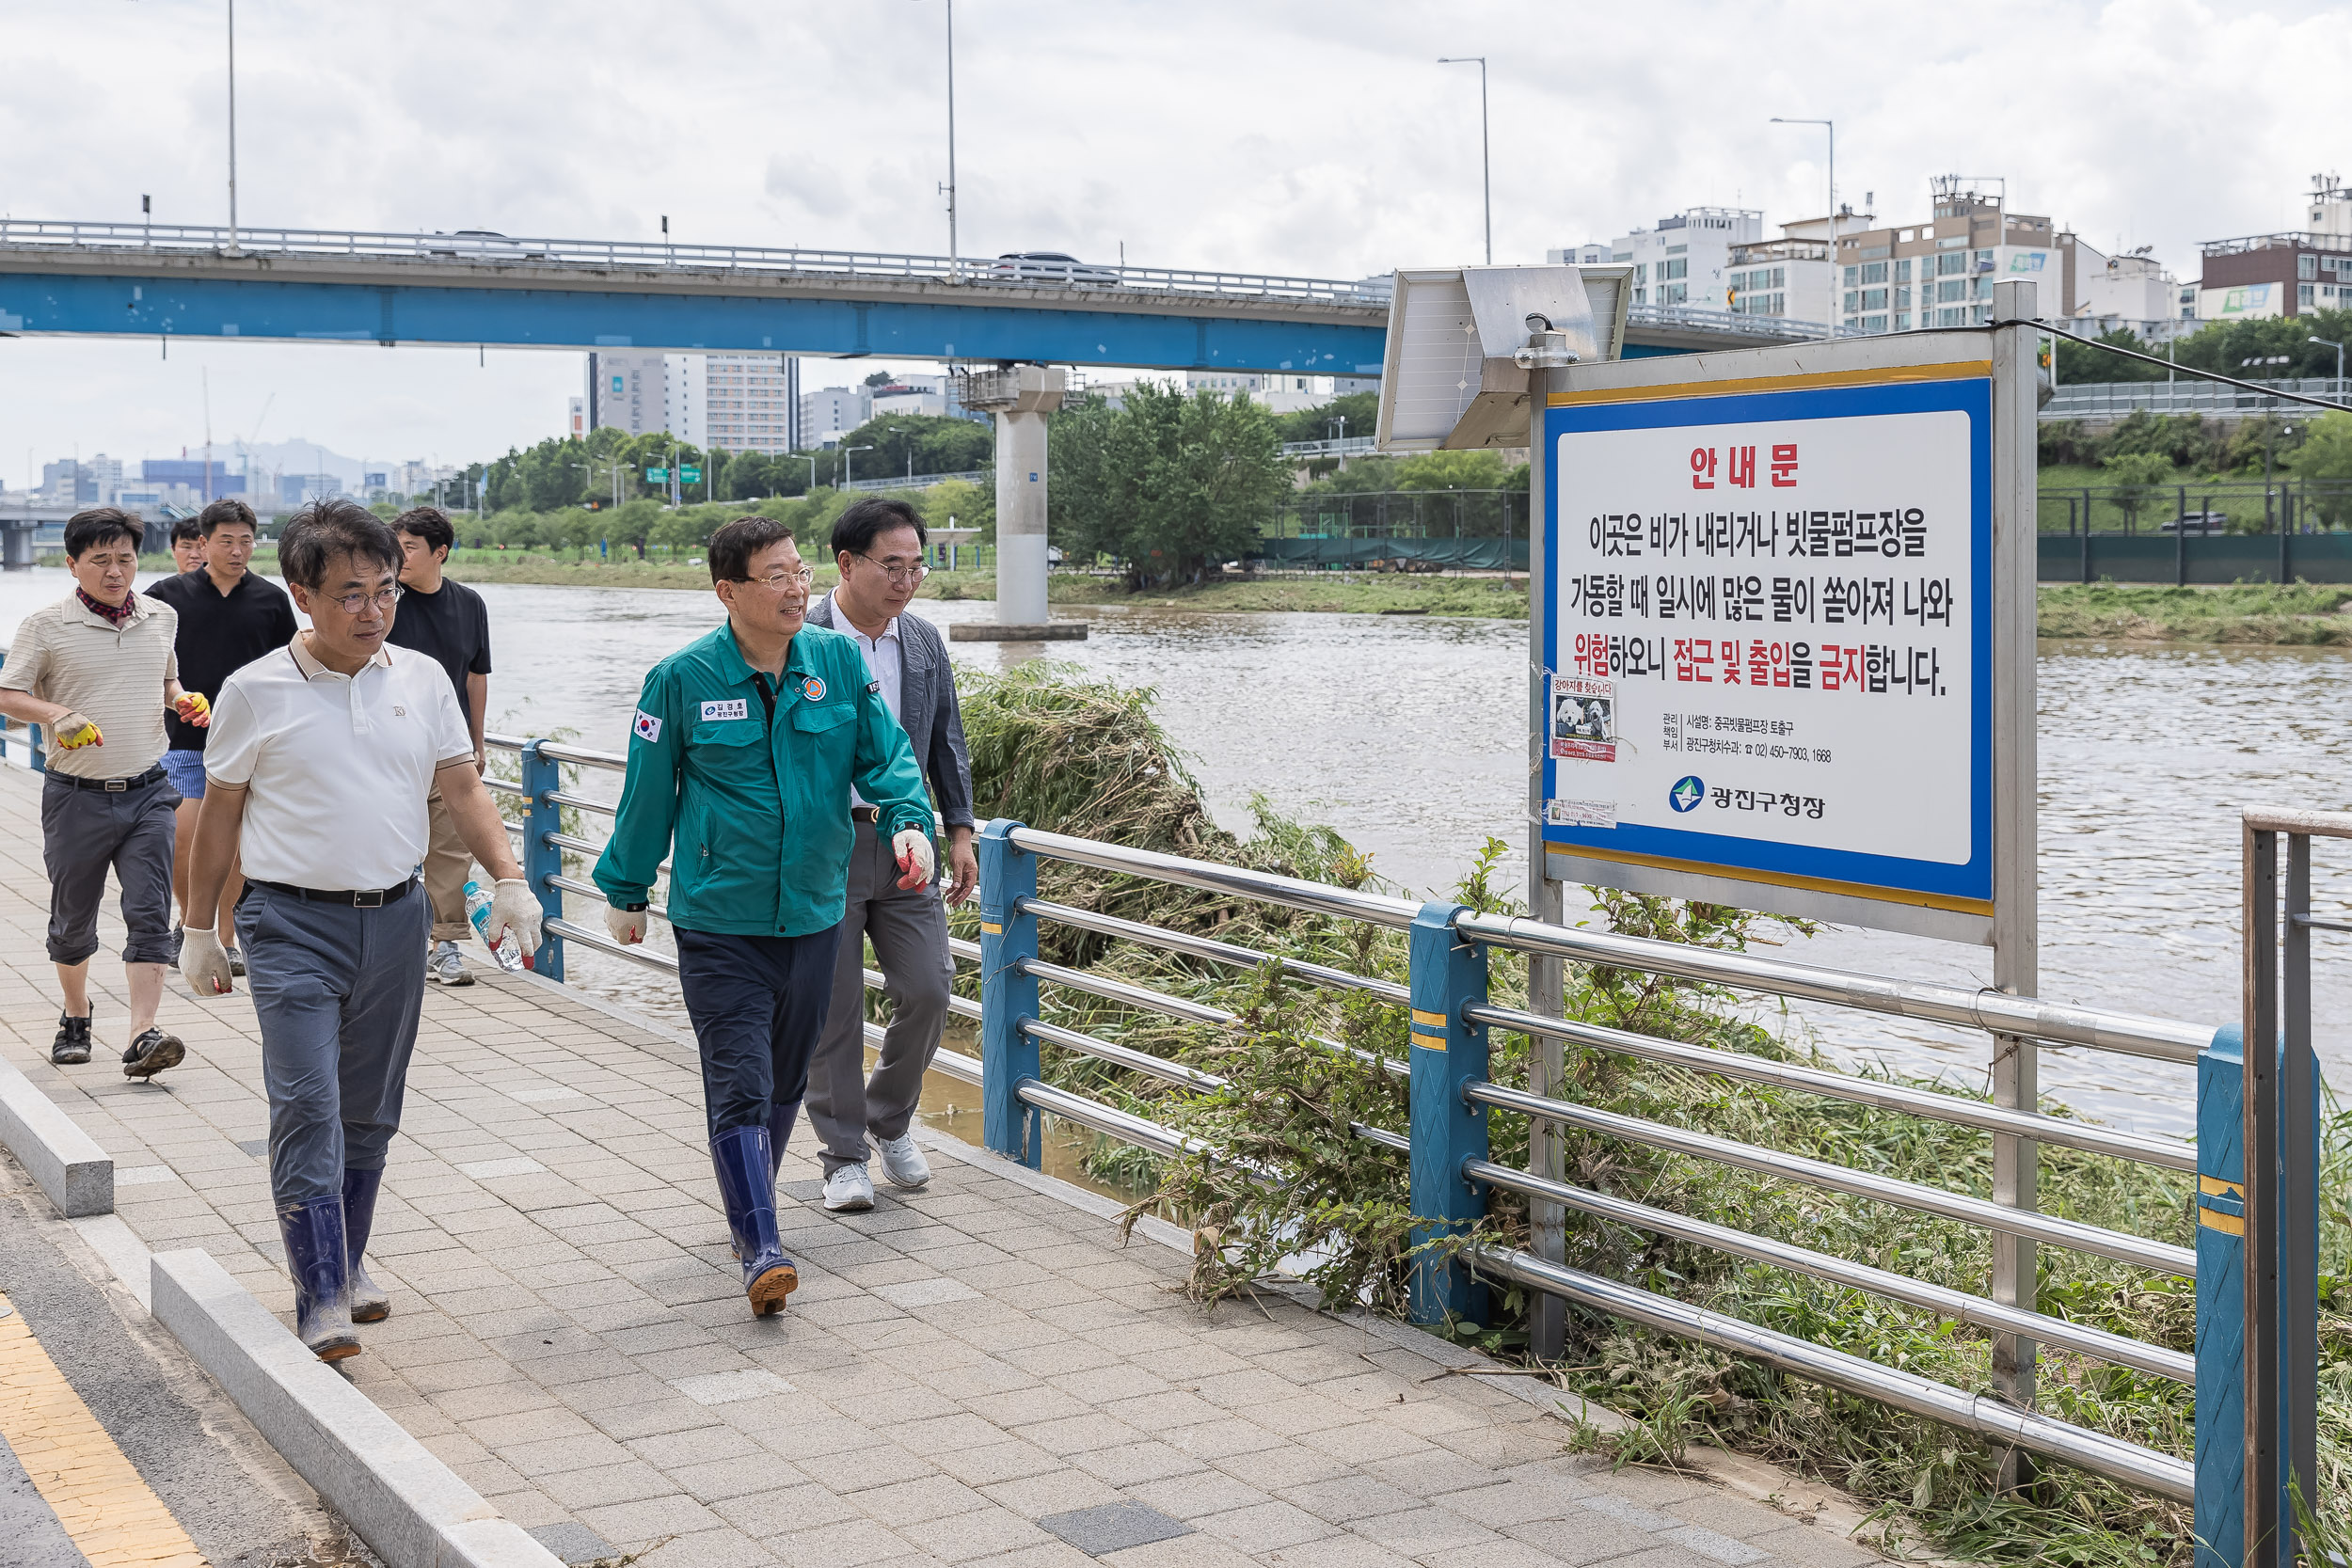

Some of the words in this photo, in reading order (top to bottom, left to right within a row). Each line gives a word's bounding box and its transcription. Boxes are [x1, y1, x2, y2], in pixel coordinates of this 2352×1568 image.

[1691, 448, 1717, 489] 안
[1729, 446, 1756, 488] 내
[1772, 444, 1798, 487] 문
[1590, 514, 1643, 556] 이곳은
[1650, 513, 1688, 557] 비가
[1696, 512, 1778, 557] 내리거나
[1787, 508, 1927, 558] 빗물펌프장을
[1571, 574, 1624, 617] 가동할
[1631, 575, 1647, 618] 때
[1657, 576, 1715, 620] 일시에
[1724, 577, 1764, 622] 많은
[1772, 577, 1814, 623] 물이
[1823, 577, 1893, 626] 쏟아져
[1904, 578, 1953, 626] 나와
[1575, 634, 1664, 680] 위험하오니
[1674, 638, 1714, 682] 접근
[1722, 641, 1740, 685] 및
[1748, 640, 1812, 689] 출입을
[1820, 645, 1946, 696] 금지합니다.
[1554, 679, 1583, 693] 강아지를
[1663, 714, 1677, 724] 관리
[1663, 726, 1677, 738] 책임
[1687, 715, 1711, 729] 시설명:
[1714, 717, 1768, 734] 중곡빗물펌프장
[1771, 721, 1793, 736] 토출구
[1663, 739, 1677, 752] 부서
[1687, 737, 1741, 755] 광진구청치수과:
[1756, 743, 1767, 758] 02)
[1770, 745, 1809, 762] 450-7903,
[1813, 749, 1831, 763] 1668
[1709, 787, 1825, 818] 광진구청장
